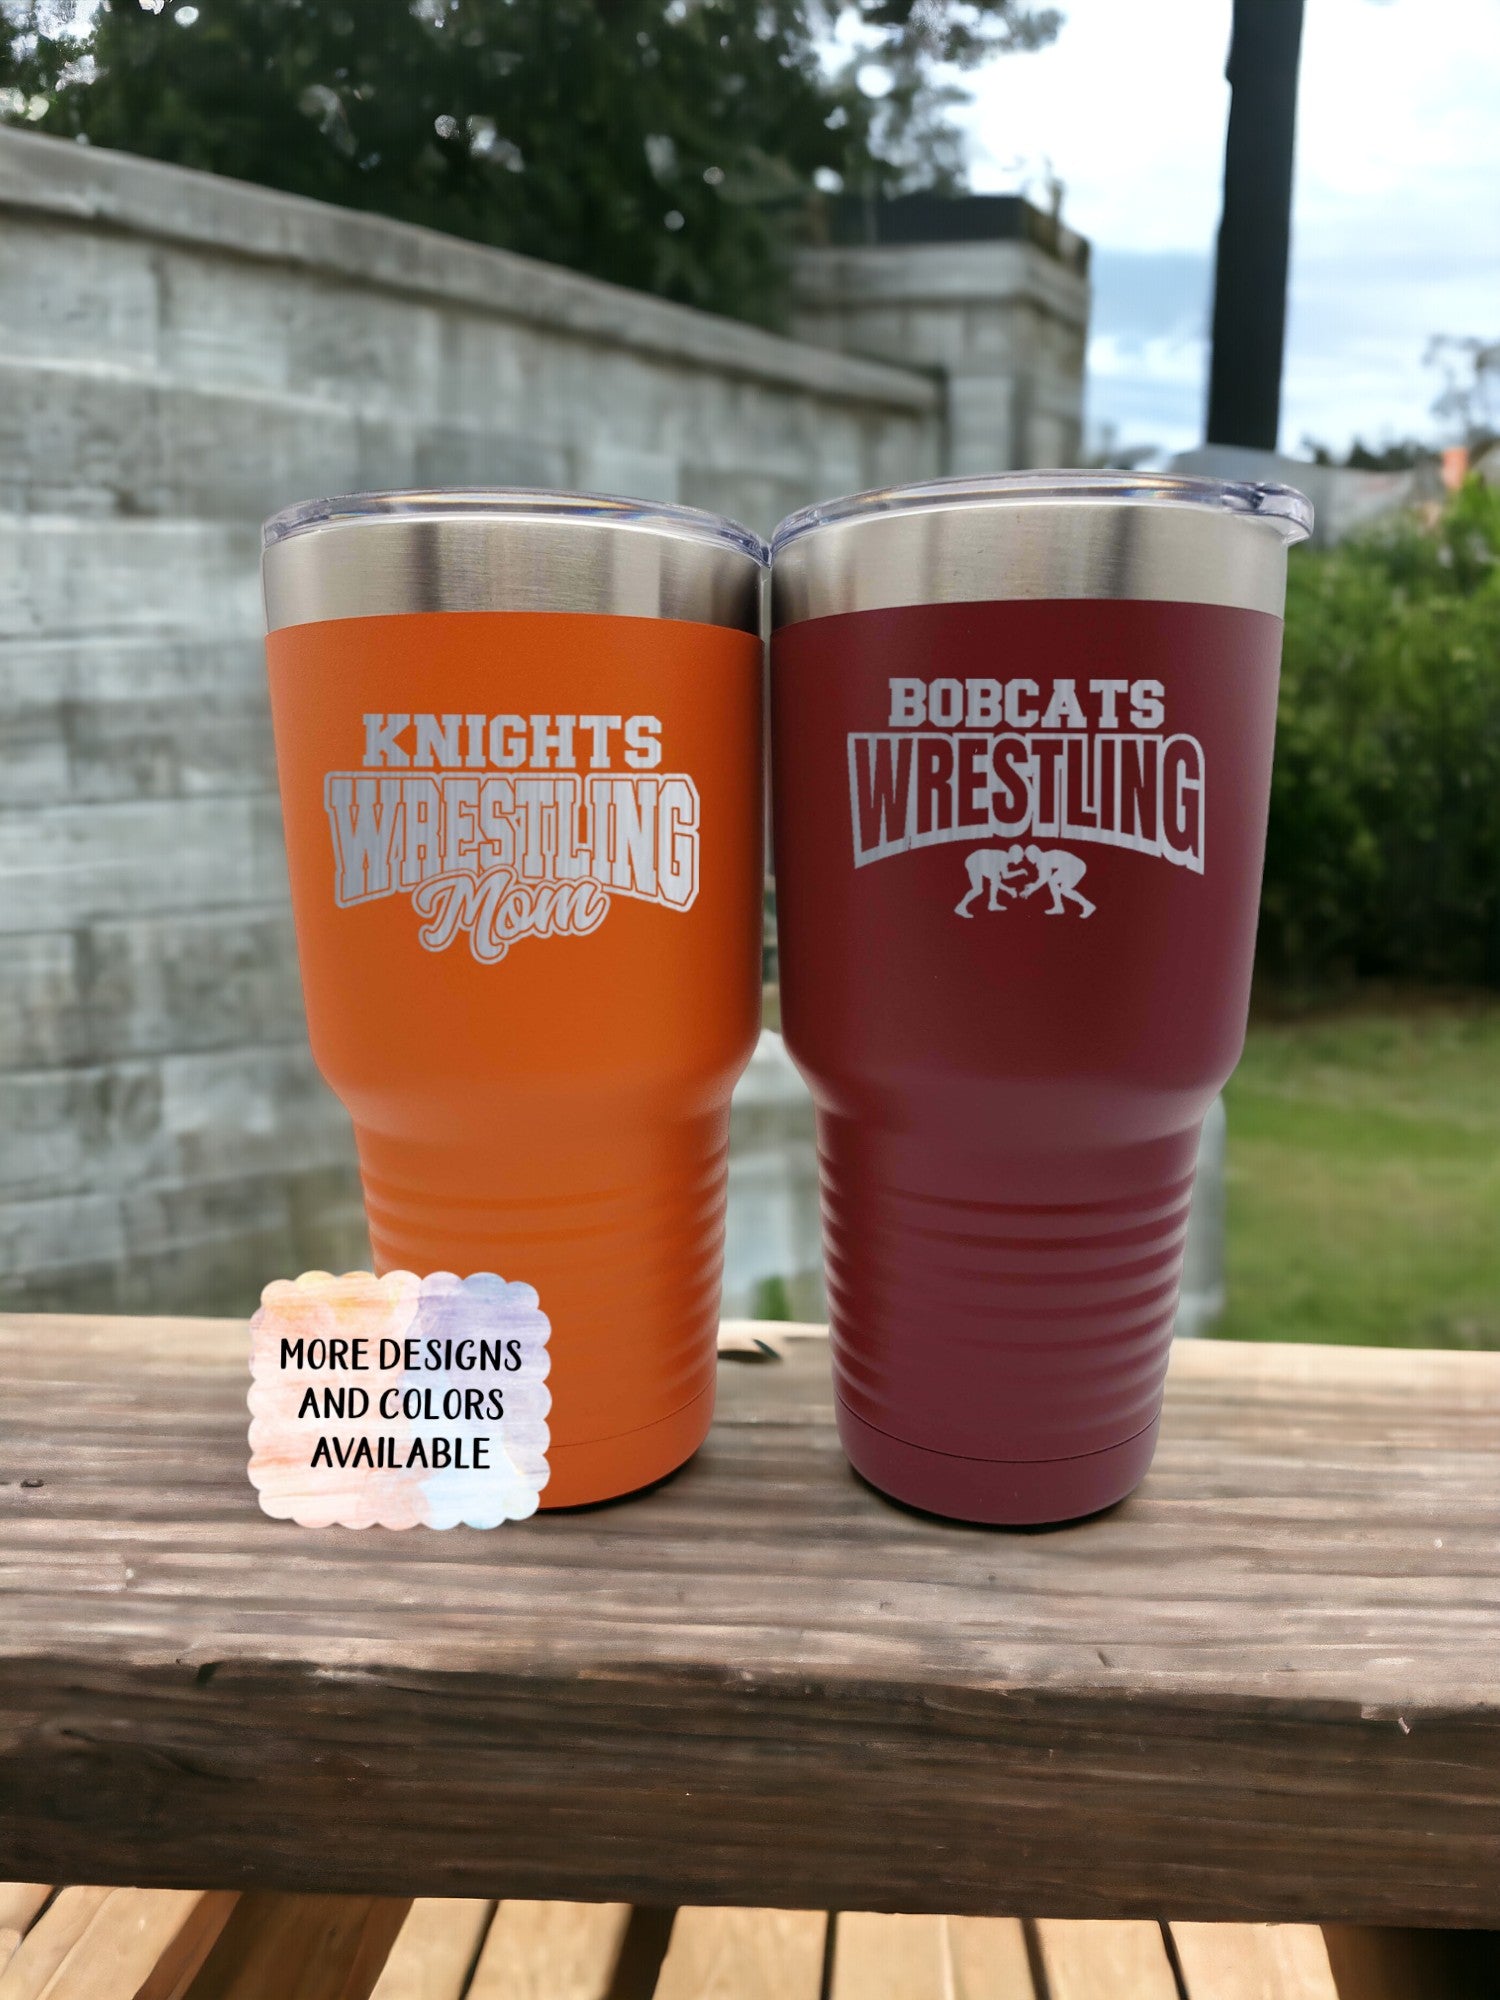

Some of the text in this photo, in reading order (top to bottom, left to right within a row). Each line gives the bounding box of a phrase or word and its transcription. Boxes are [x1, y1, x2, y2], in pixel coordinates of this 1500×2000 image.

[362, 713, 662, 769] KNIGHTS
[888, 677, 1165, 729] BOBCATS
[324, 771, 701, 913] WRESTLING
[847, 732, 1206, 875] WRESTLING
[412, 864, 611, 965] Mom
